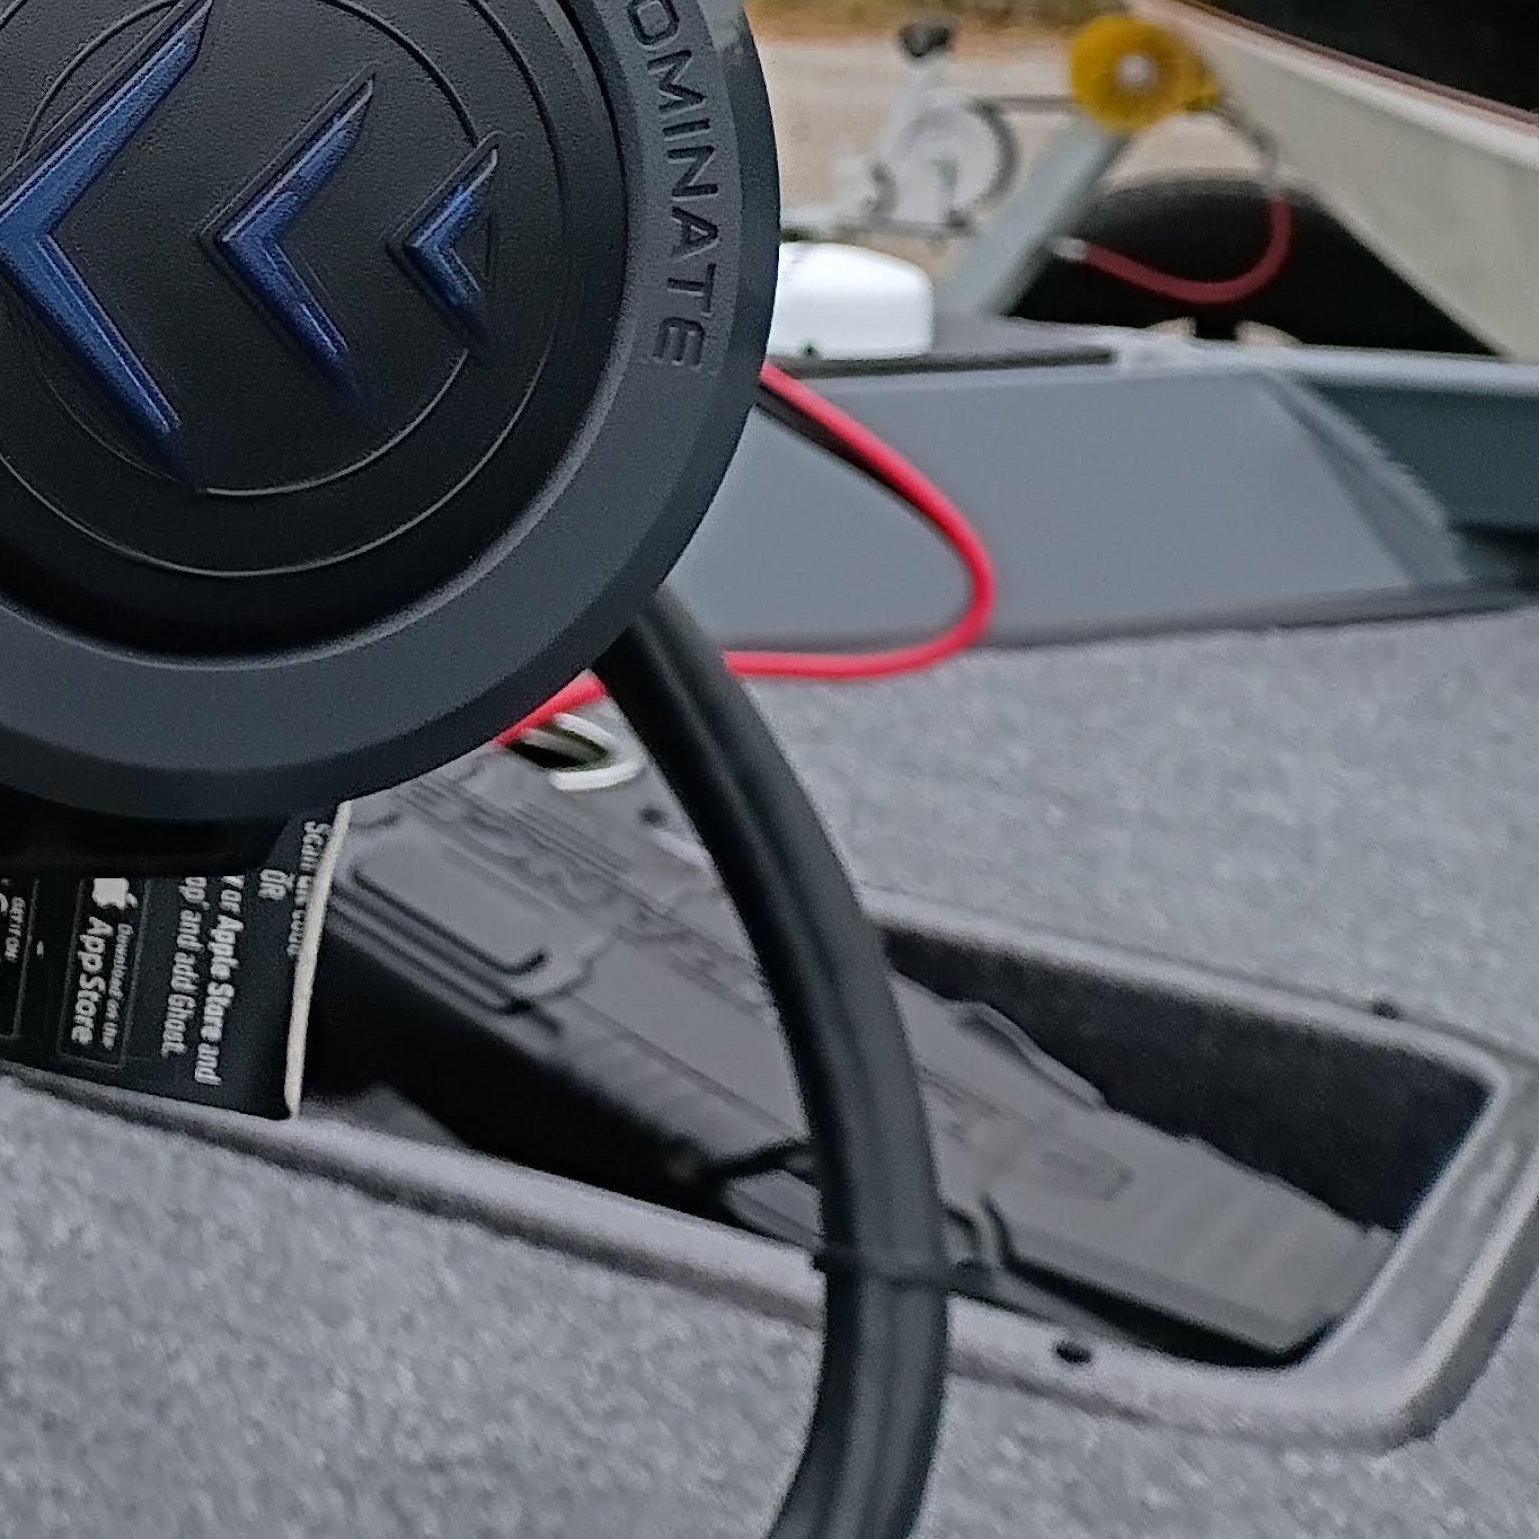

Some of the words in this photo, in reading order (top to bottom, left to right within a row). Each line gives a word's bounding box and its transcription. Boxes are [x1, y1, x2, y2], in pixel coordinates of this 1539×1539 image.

[219, 889, 242, 914] or
[77, 916, 114, 972] App
[176, 910, 205, 953] and
[207, 914, 244, 980] Apple
[108, 923, 134, 1000] Download
[171, 951, 200, 994] add
[71, 973, 106, 1044] Store
[106, 998, 119, 1022] on
[200, 981, 235, 1042] Store
[194, 1043, 222, 1086] and
